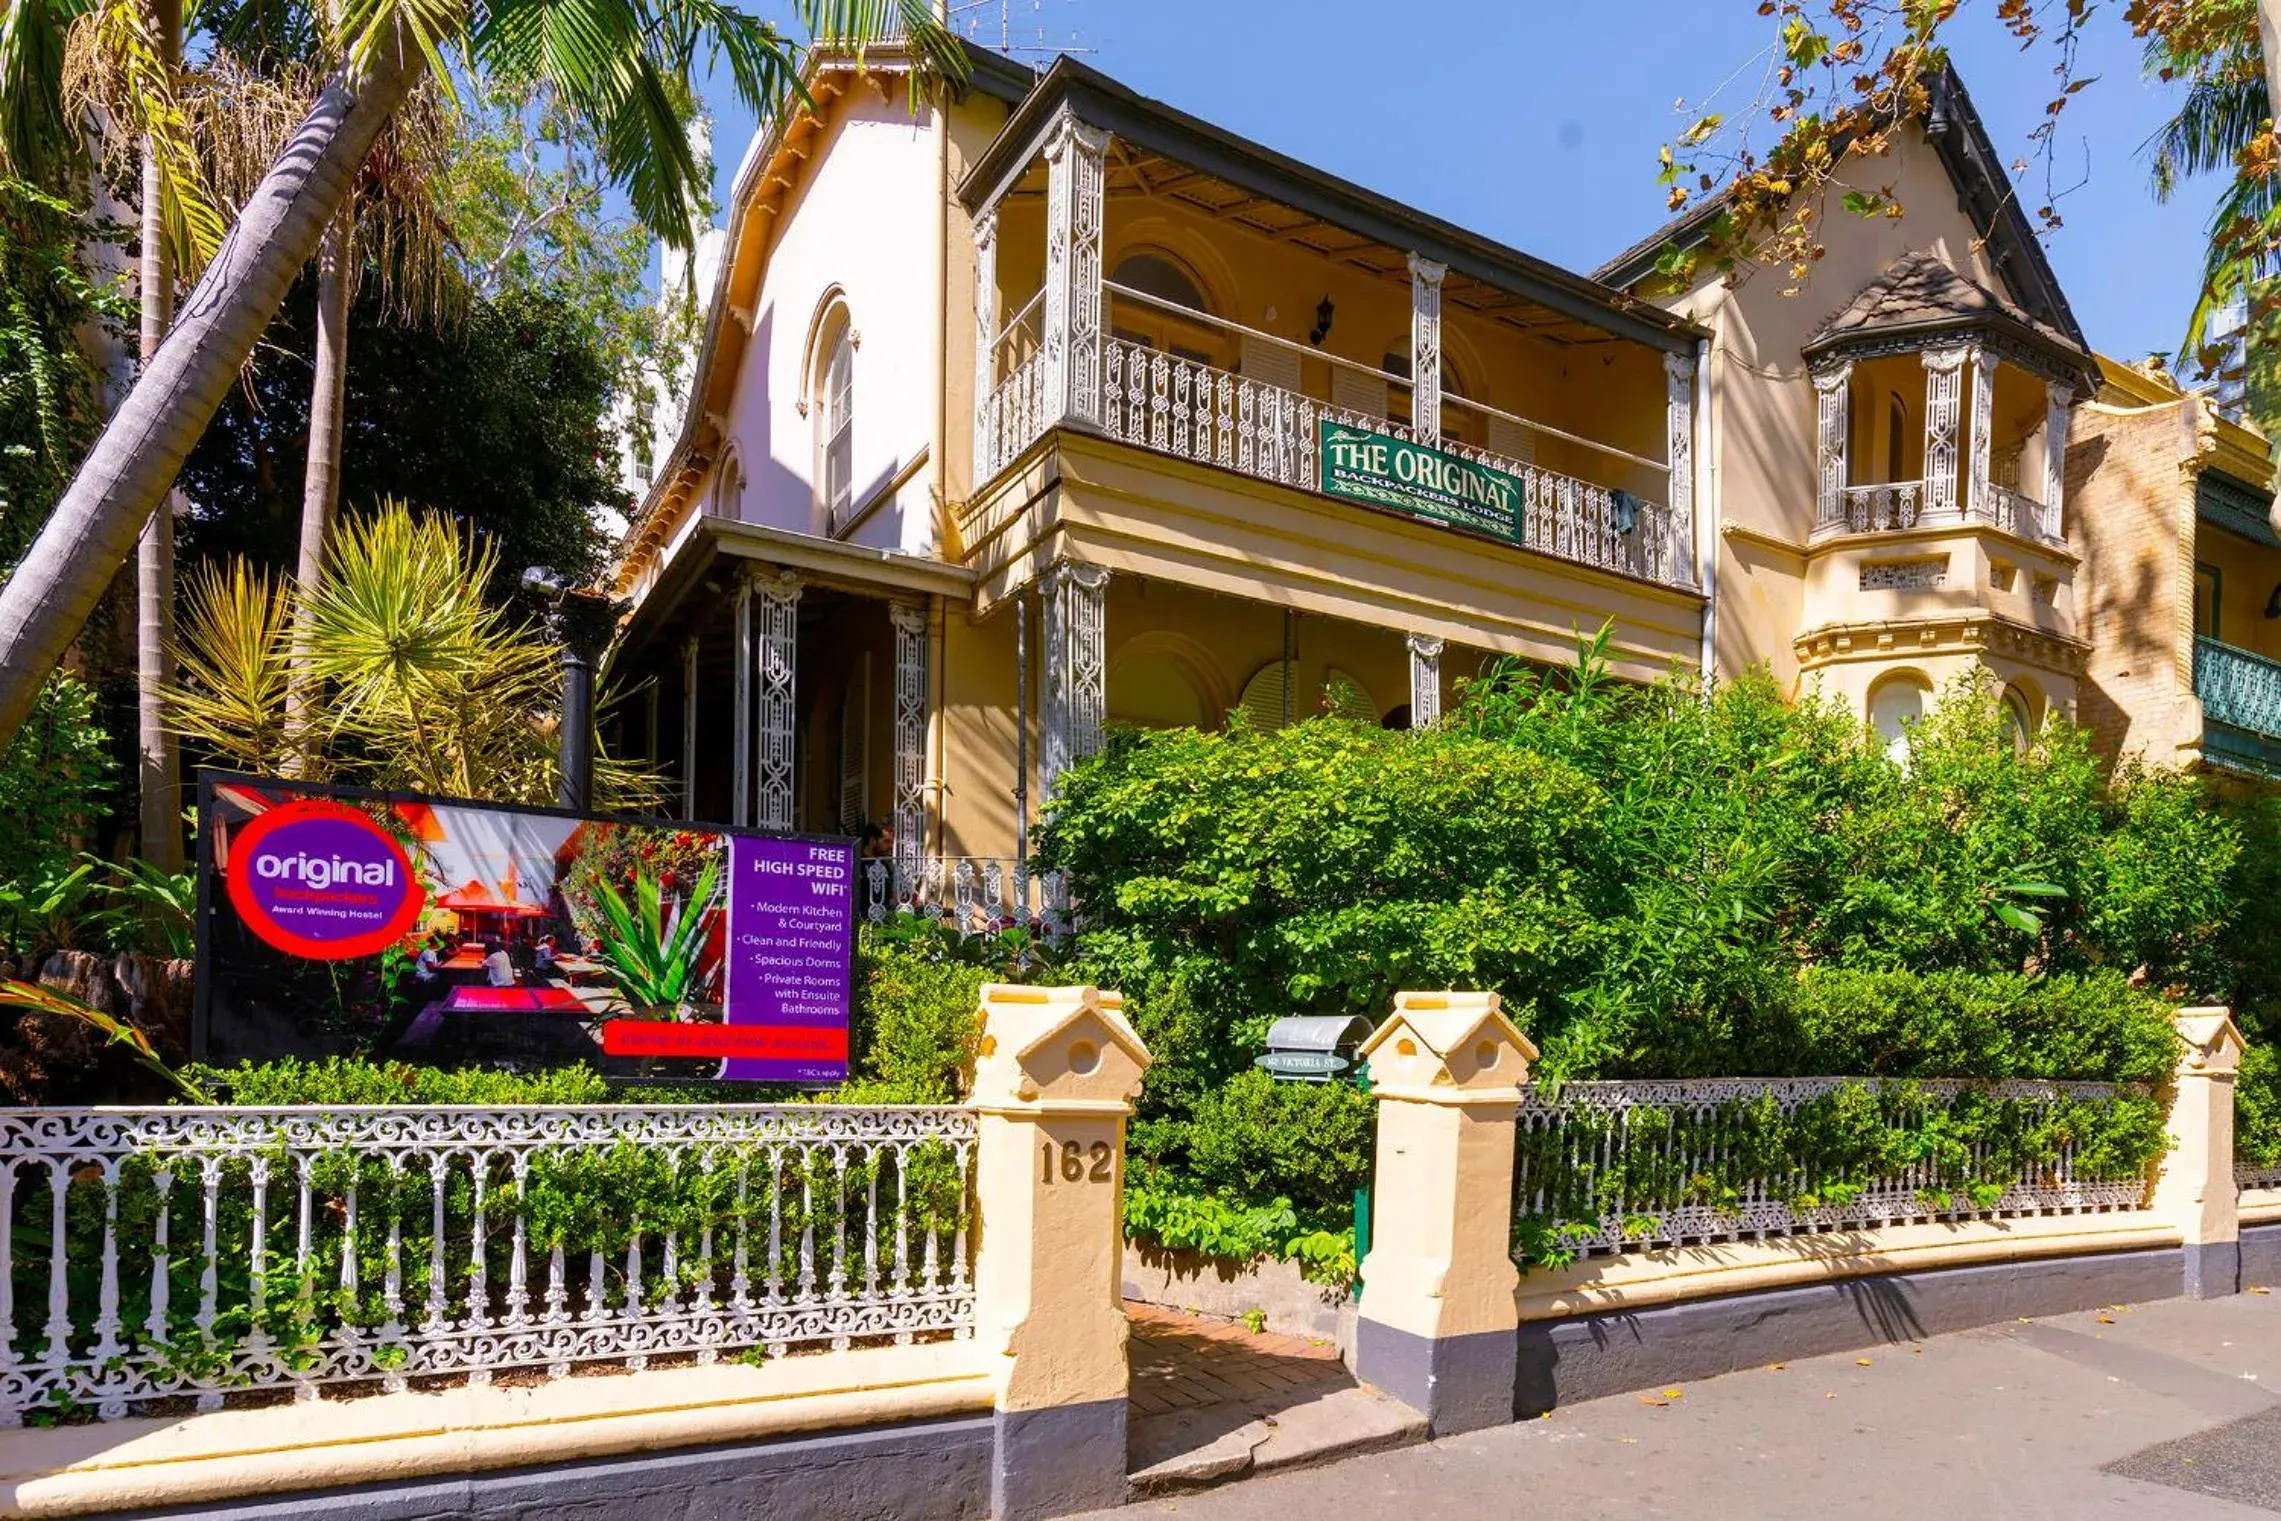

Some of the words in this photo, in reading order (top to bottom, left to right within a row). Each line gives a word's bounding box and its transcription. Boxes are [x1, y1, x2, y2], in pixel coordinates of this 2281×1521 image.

[1329, 444, 1389, 476] THE
[1395, 448, 1515, 513] ORIGINAL
[1334, 469, 1460, 508] BACKPACKERS
[1464, 502, 1515, 524] LODGE
[809, 848, 845, 863] FREE
[256, 851, 394, 889] original
[754, 860, 793, 876] HIGH
[797, 864, 845, 879] SPEED
[272, 905, 304, 915] Award
[307, 907, 347, 919] Winning
[349, 910, 383, 920] Hostel
[756, 901, 800, 915] Modern
[802, 905, 843, 918] Kitchen
[778, 918, 787, 929] &
[788, 918, 842, 933] Courtyard
[742, 934, 774, 947] Clean
[775, 936, 797, 948] and
[799, 938, 842, 952] Friendly
[755, 954, 804, 967] Spacious
[806, 956, 842, 969] Dorms
[764, 973, 802, 985] Private
[803, 976, 841, 987] Rooms
[774, 989, 798, 1000] with
[801, 990, 840, 1001] Ensuite
[781, 1003, 840, 1016] Bathrooms
[1041, 1140, 1112, 1185] 162
